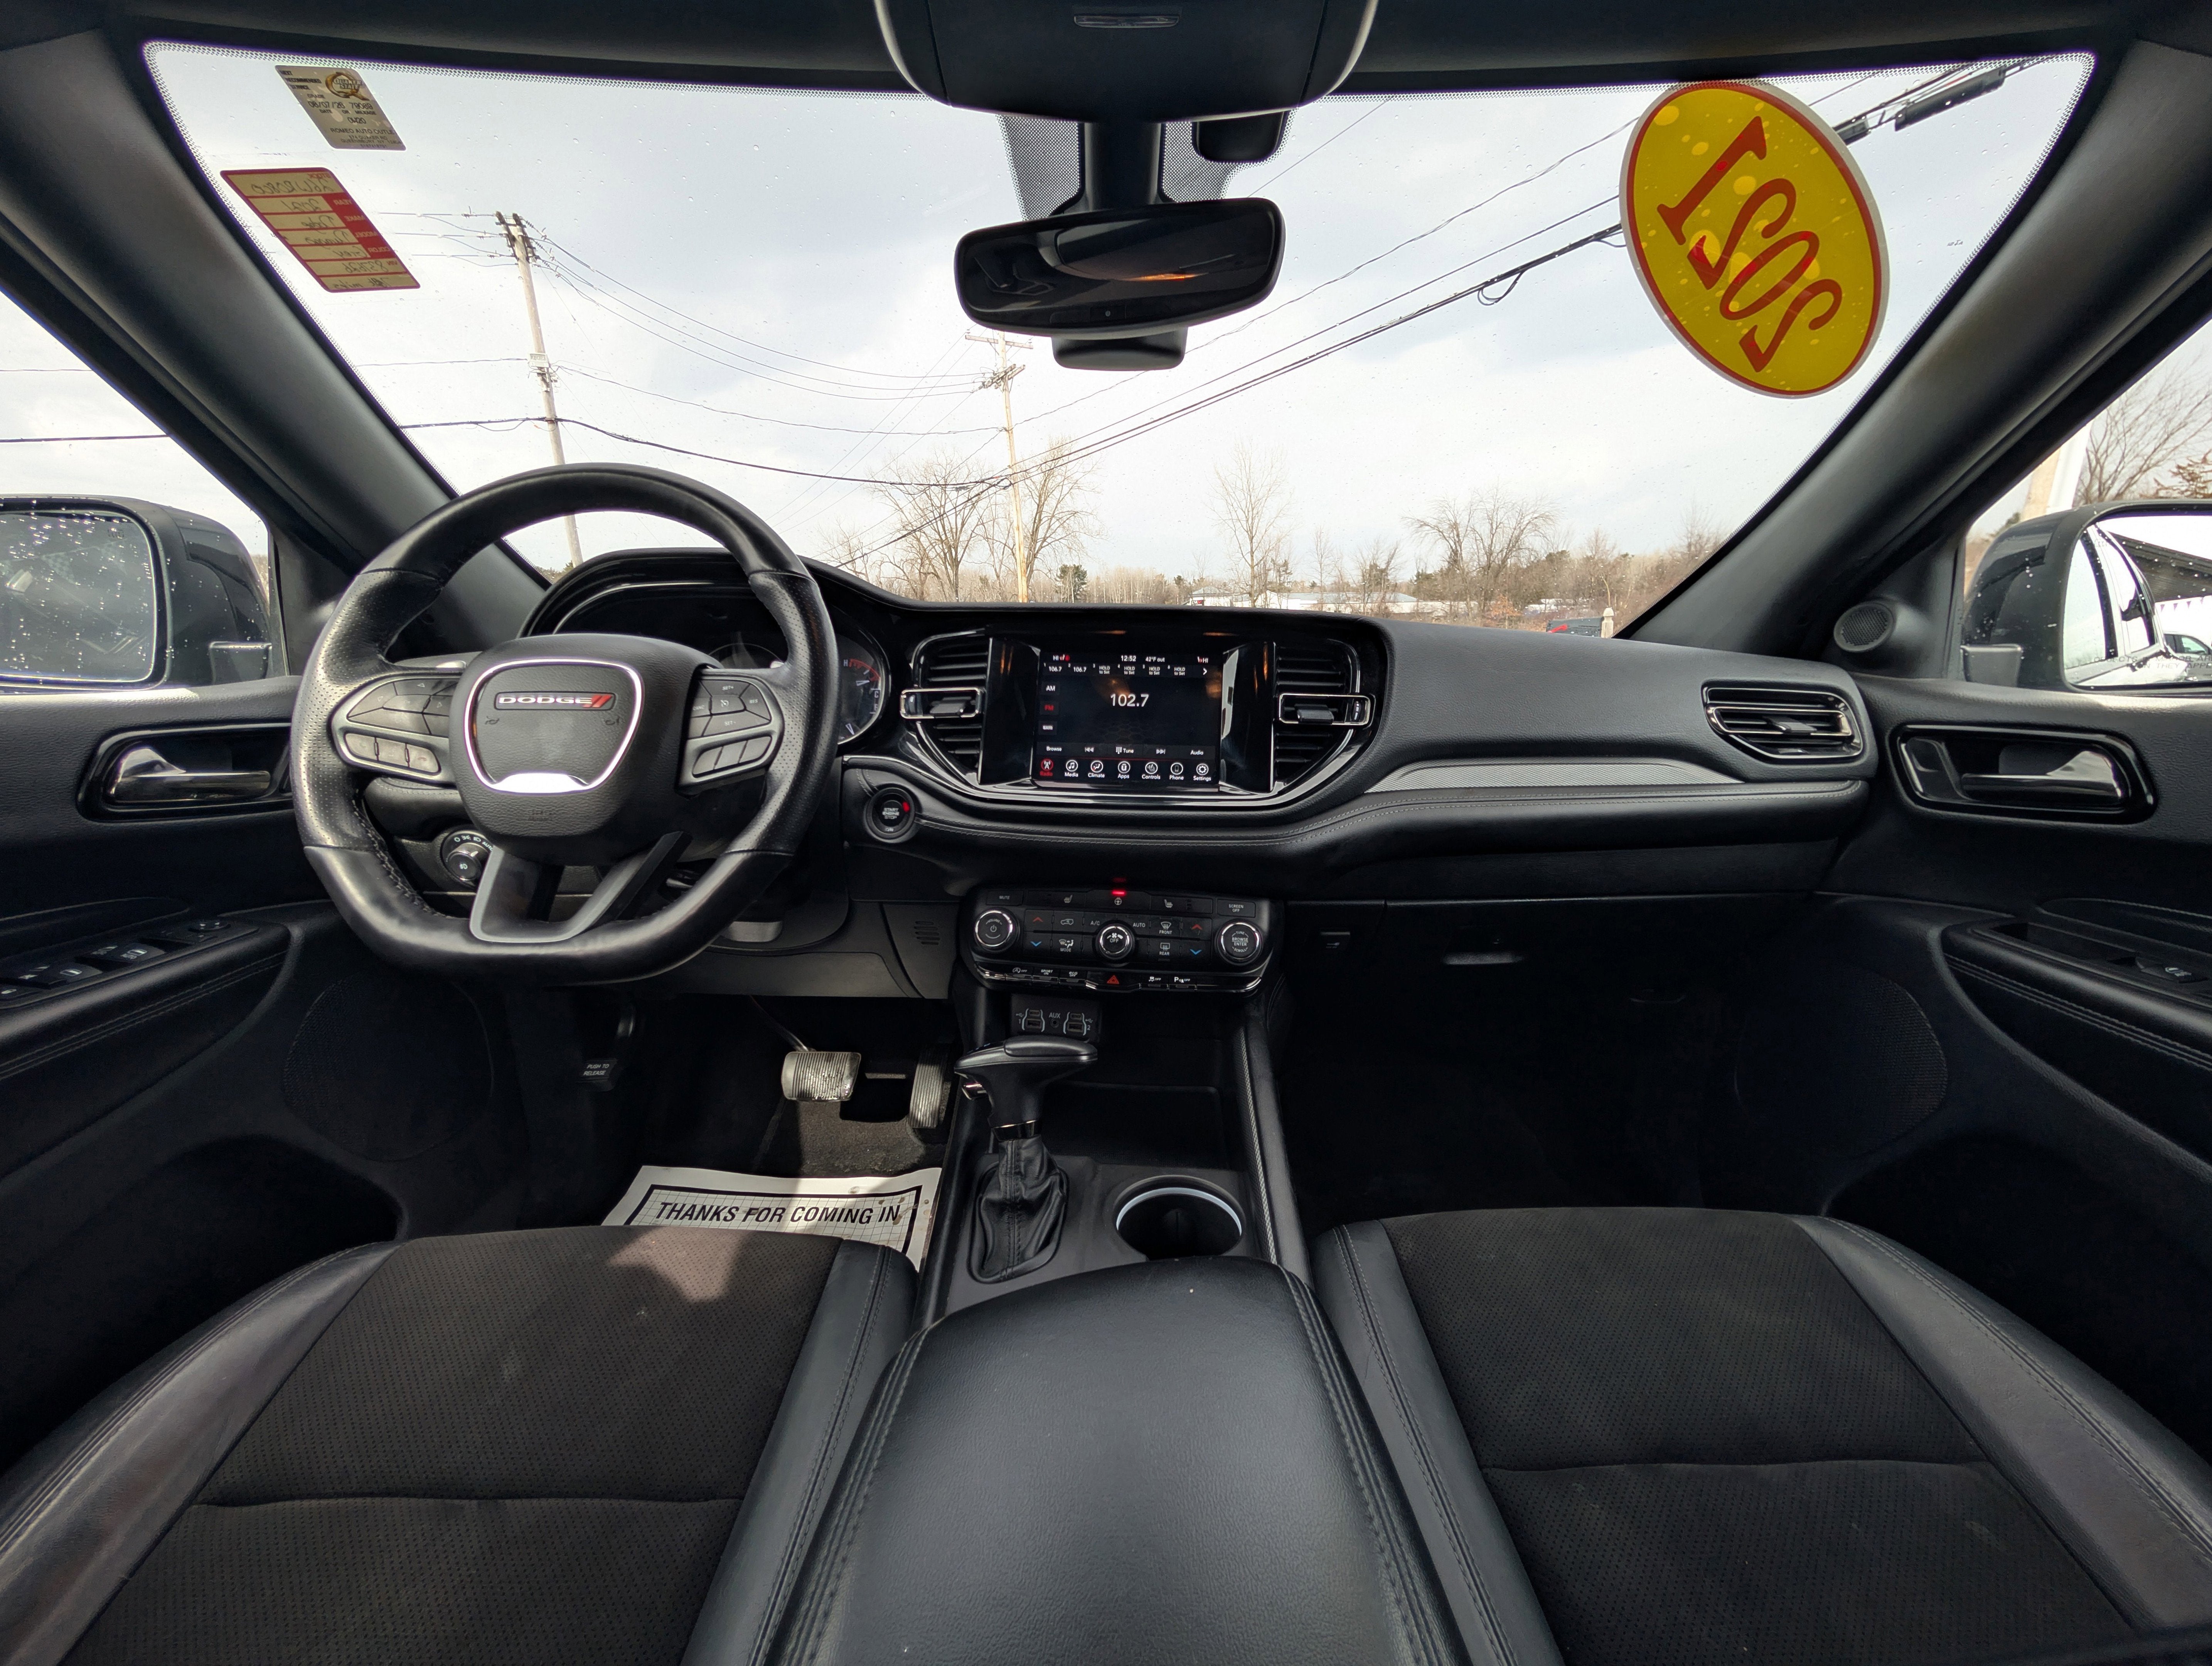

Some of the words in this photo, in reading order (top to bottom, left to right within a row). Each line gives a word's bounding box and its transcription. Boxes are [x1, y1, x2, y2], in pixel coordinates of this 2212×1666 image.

[333, 78, 362, 86] QUAKER
[1110, 693, 1149, 707] 102.7
[658, 1201, 740, 1223] THANKS
[742, 1207, 787, 1223] FOR
[790, 1206, 874, 1224] COMING
[878, 1204, 901, 1223] IN
